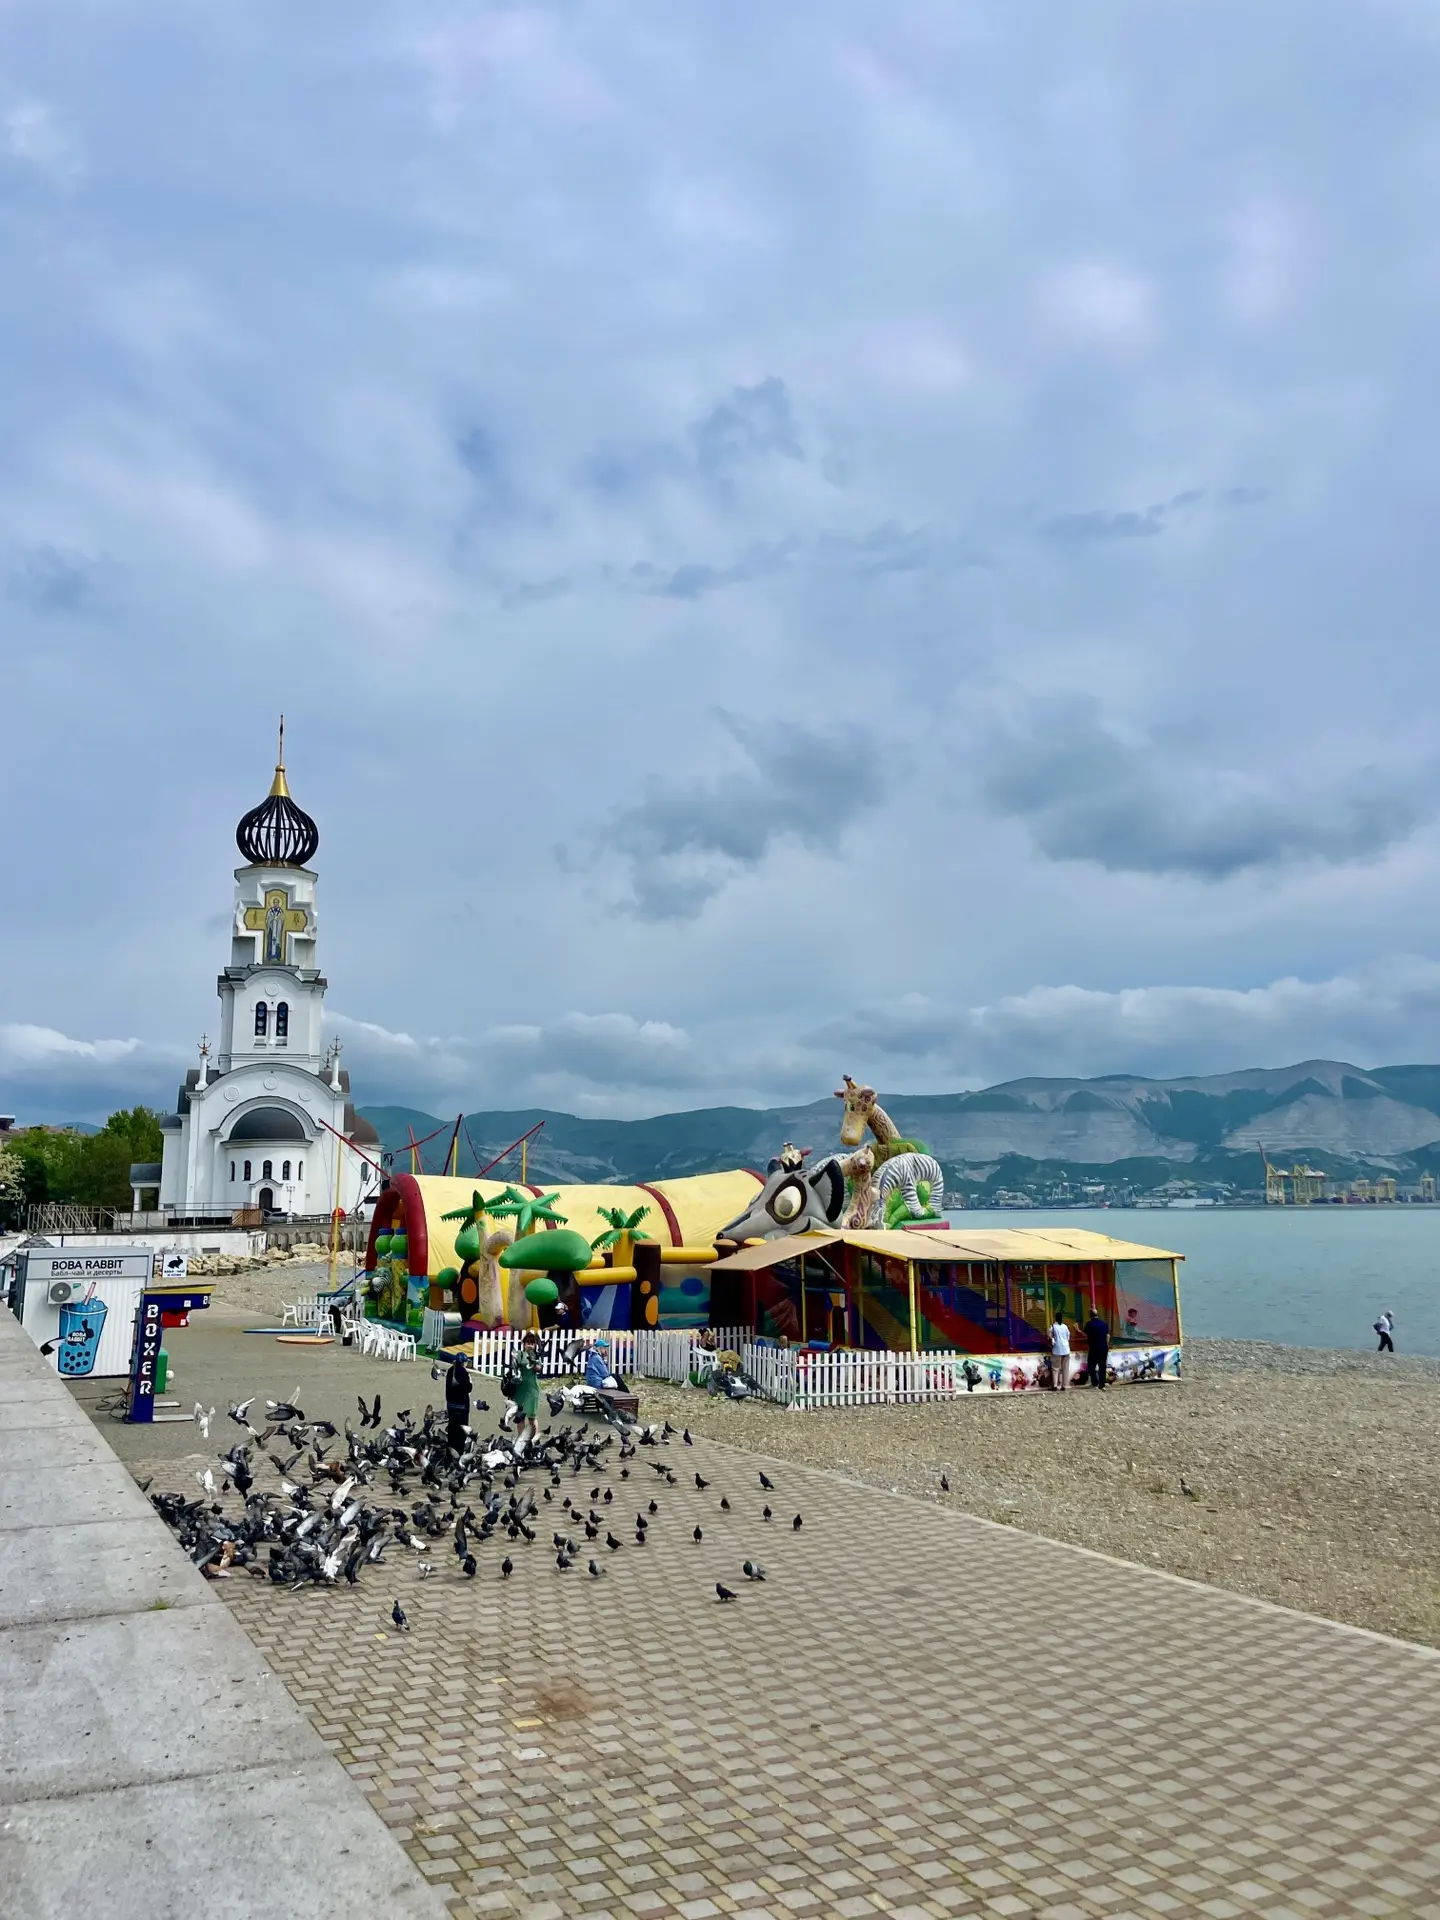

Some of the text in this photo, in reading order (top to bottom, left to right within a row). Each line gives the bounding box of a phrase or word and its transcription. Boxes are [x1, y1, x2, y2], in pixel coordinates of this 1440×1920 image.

[52, 1260, 124, 1270] BOBA RABBIT
[140, 1304, 159, 1394] BOXER
